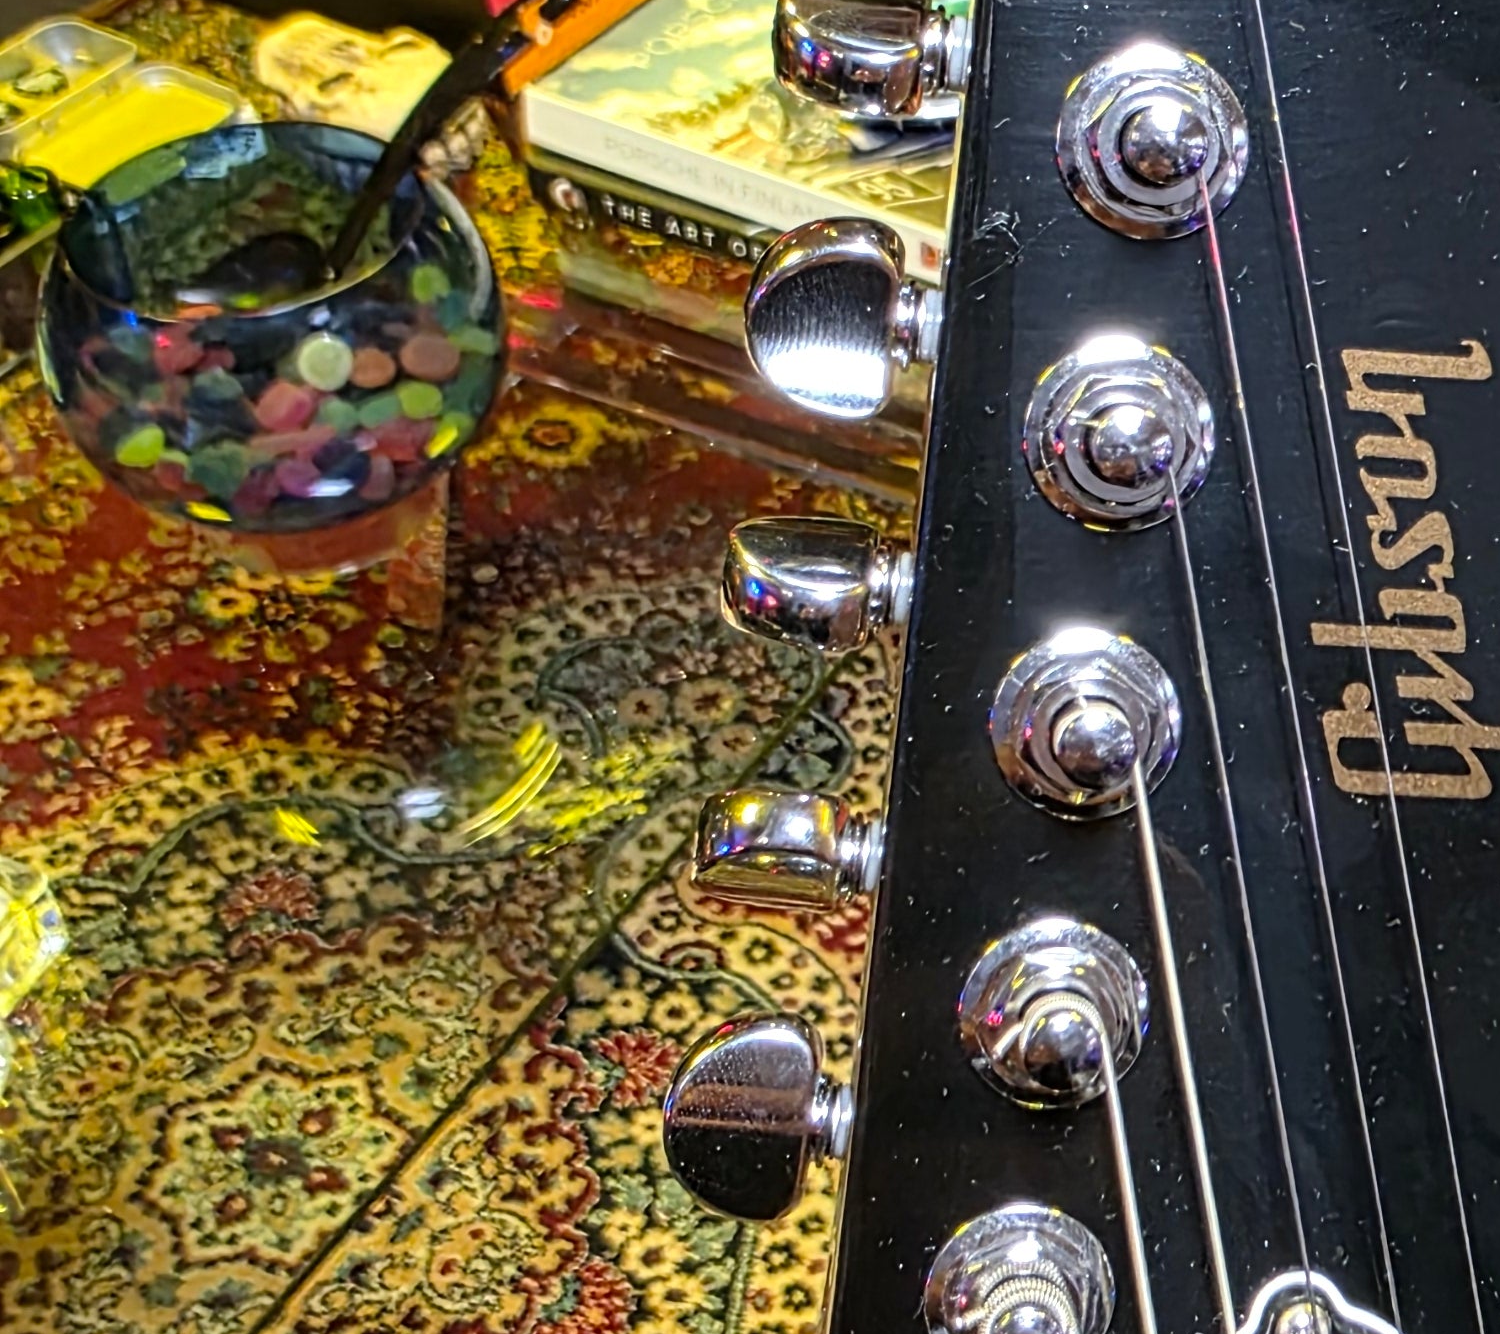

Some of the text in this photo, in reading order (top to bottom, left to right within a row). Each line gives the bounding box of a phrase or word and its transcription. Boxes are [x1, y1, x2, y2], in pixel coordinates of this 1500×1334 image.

[713, 172, 736, 196] IN
[601, 195, 652, 229] THE
[665, 216, 716, 247] ART
